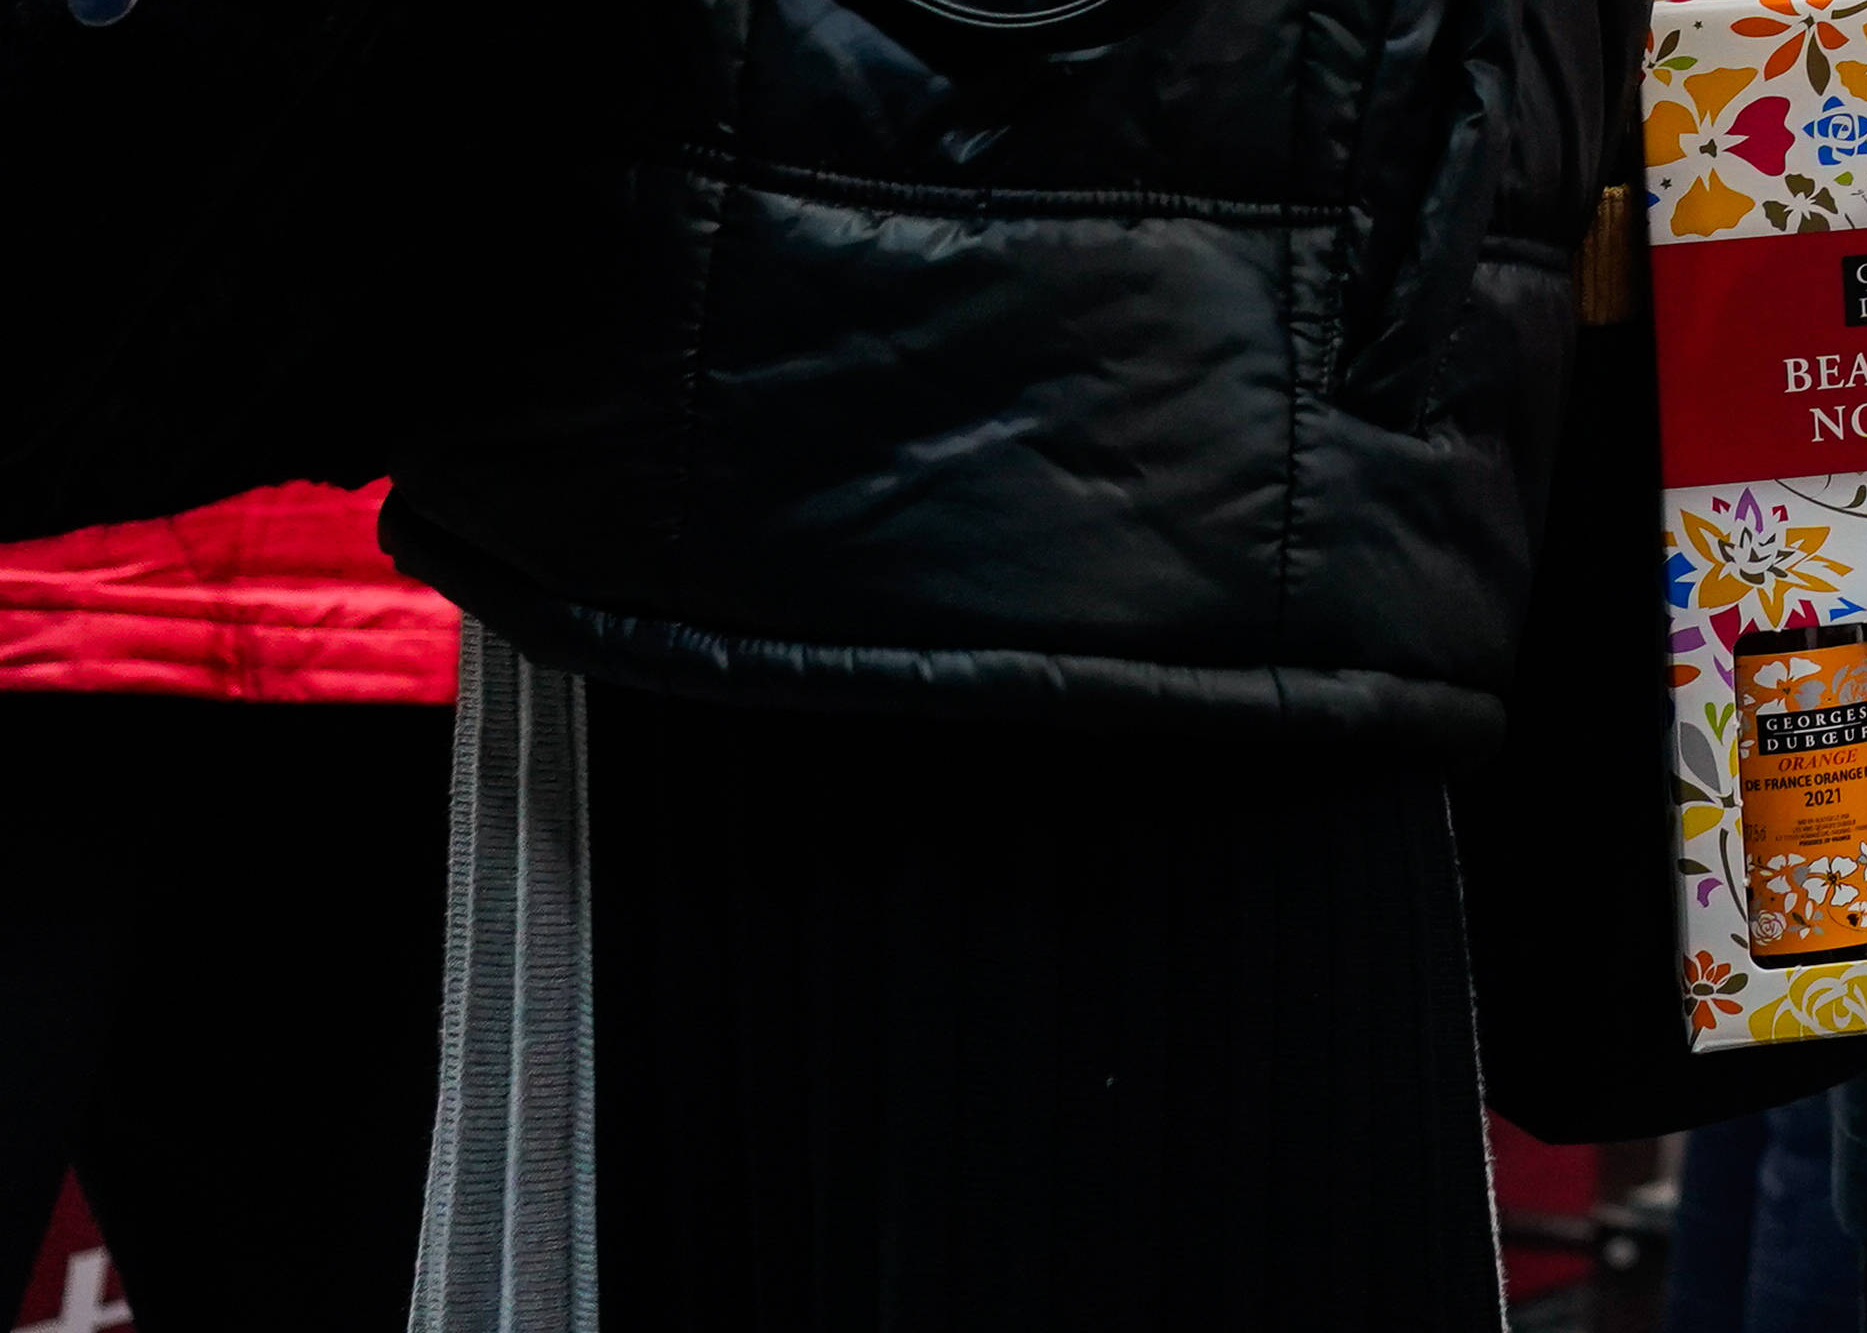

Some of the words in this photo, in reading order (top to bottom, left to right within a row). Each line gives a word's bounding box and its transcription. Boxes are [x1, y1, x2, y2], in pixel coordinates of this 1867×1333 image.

[1765, 705, 1867, 732] GEORGES
[1777, 748, 1859, 773] ORANGE
[1764, 774, 1812, 790] FRANCE
[1813, 766, 1864, 786] ORANGE
[1803, 788, 1842, 808] 2021
